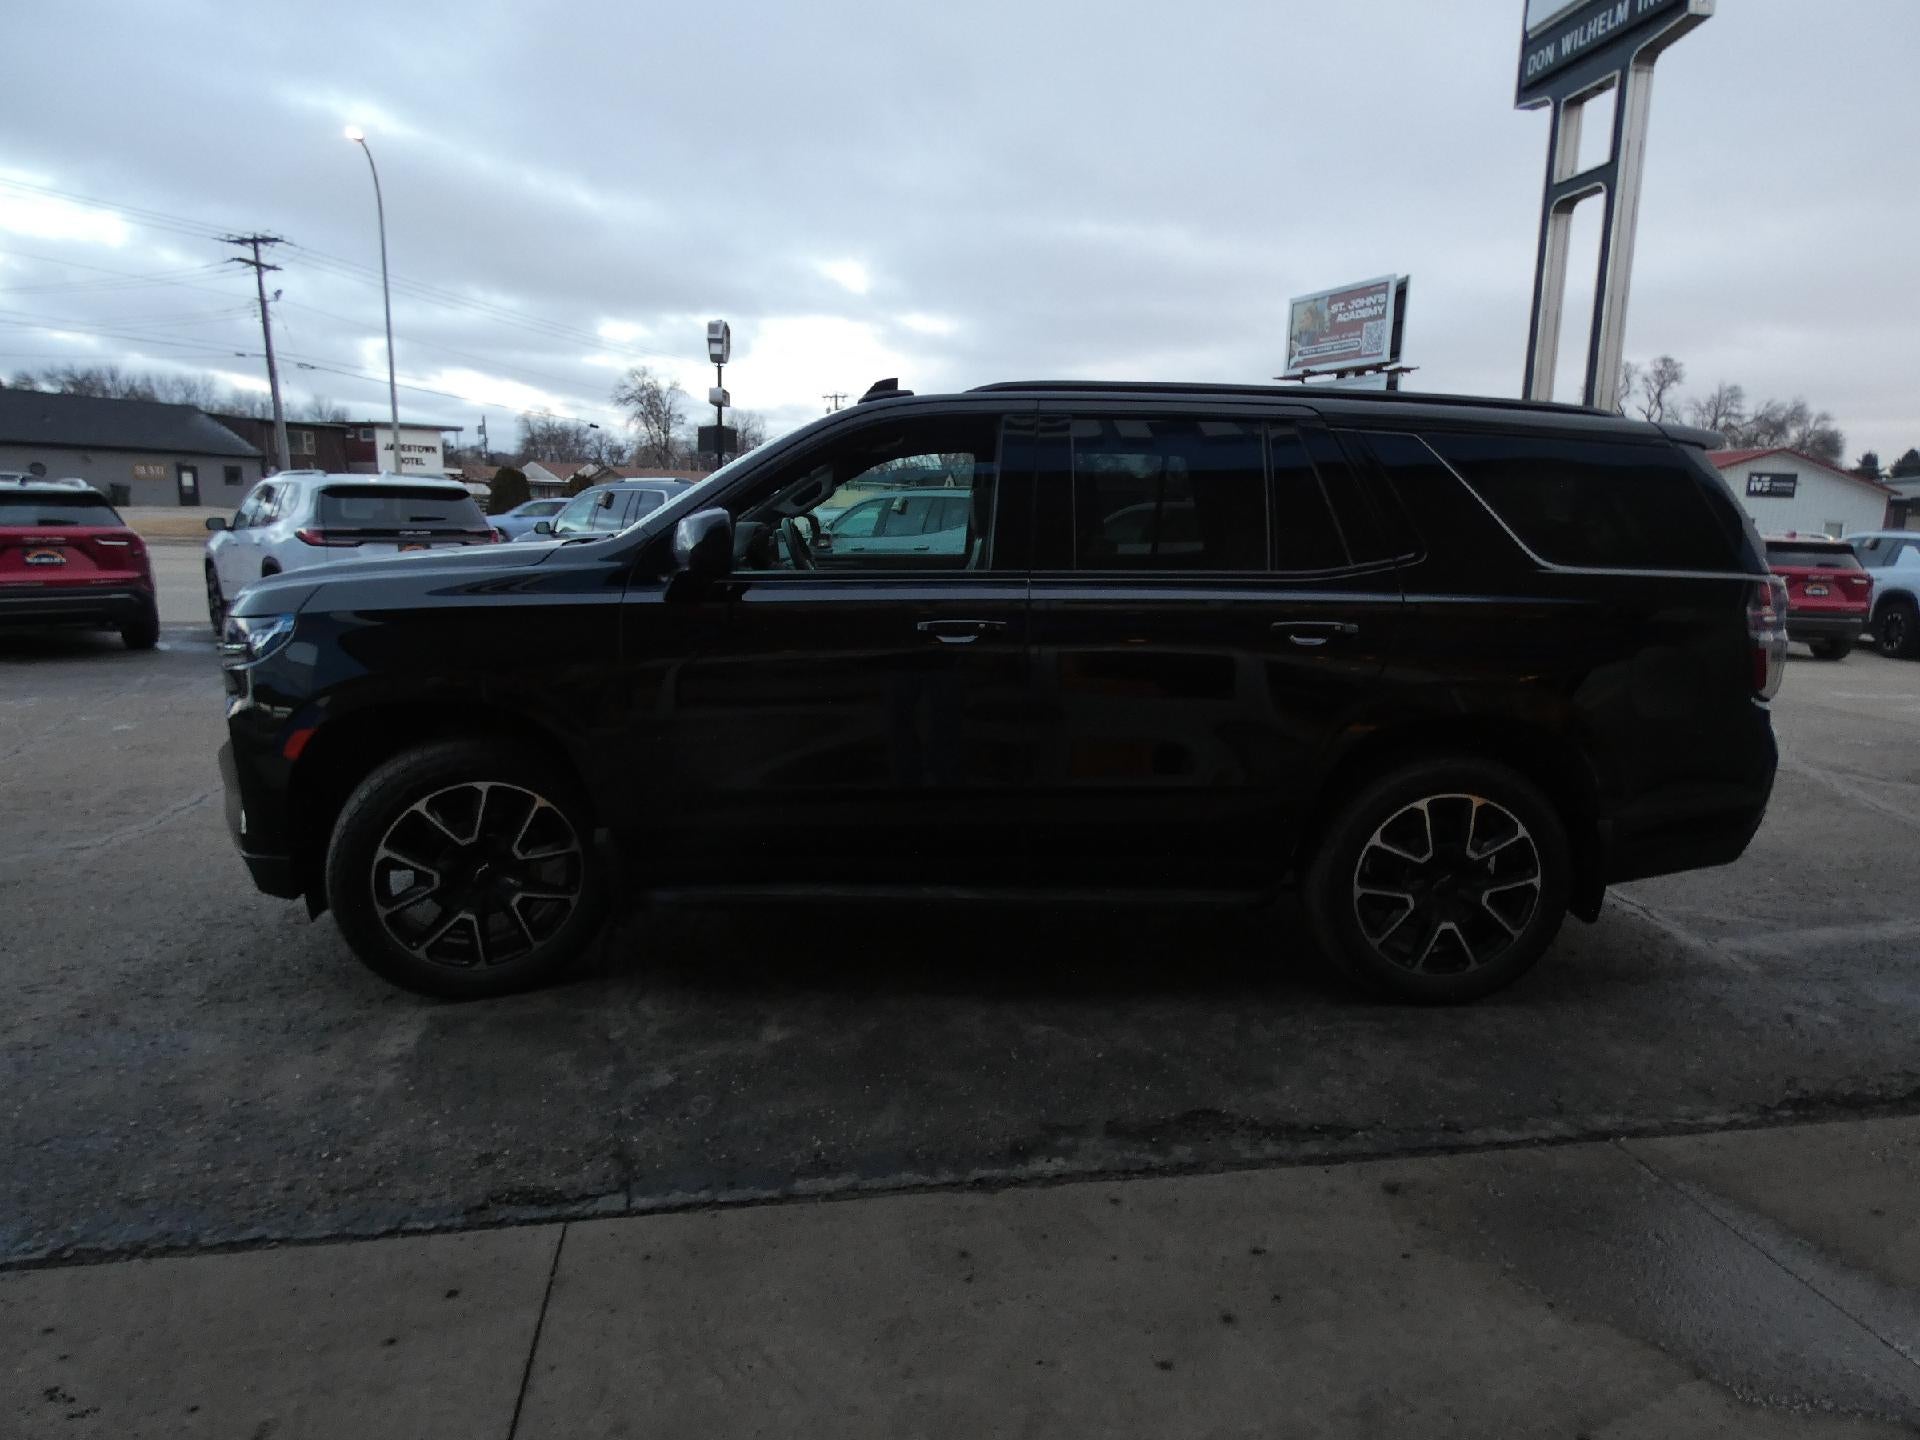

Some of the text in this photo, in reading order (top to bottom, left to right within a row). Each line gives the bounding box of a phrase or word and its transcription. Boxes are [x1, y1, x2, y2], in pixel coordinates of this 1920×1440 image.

[1527, 0, 1629, 76] DON WILHELM
[1336, 304, 1385, 321] ACADEMY
[384, 443, 437, 453] JAESTOWN
